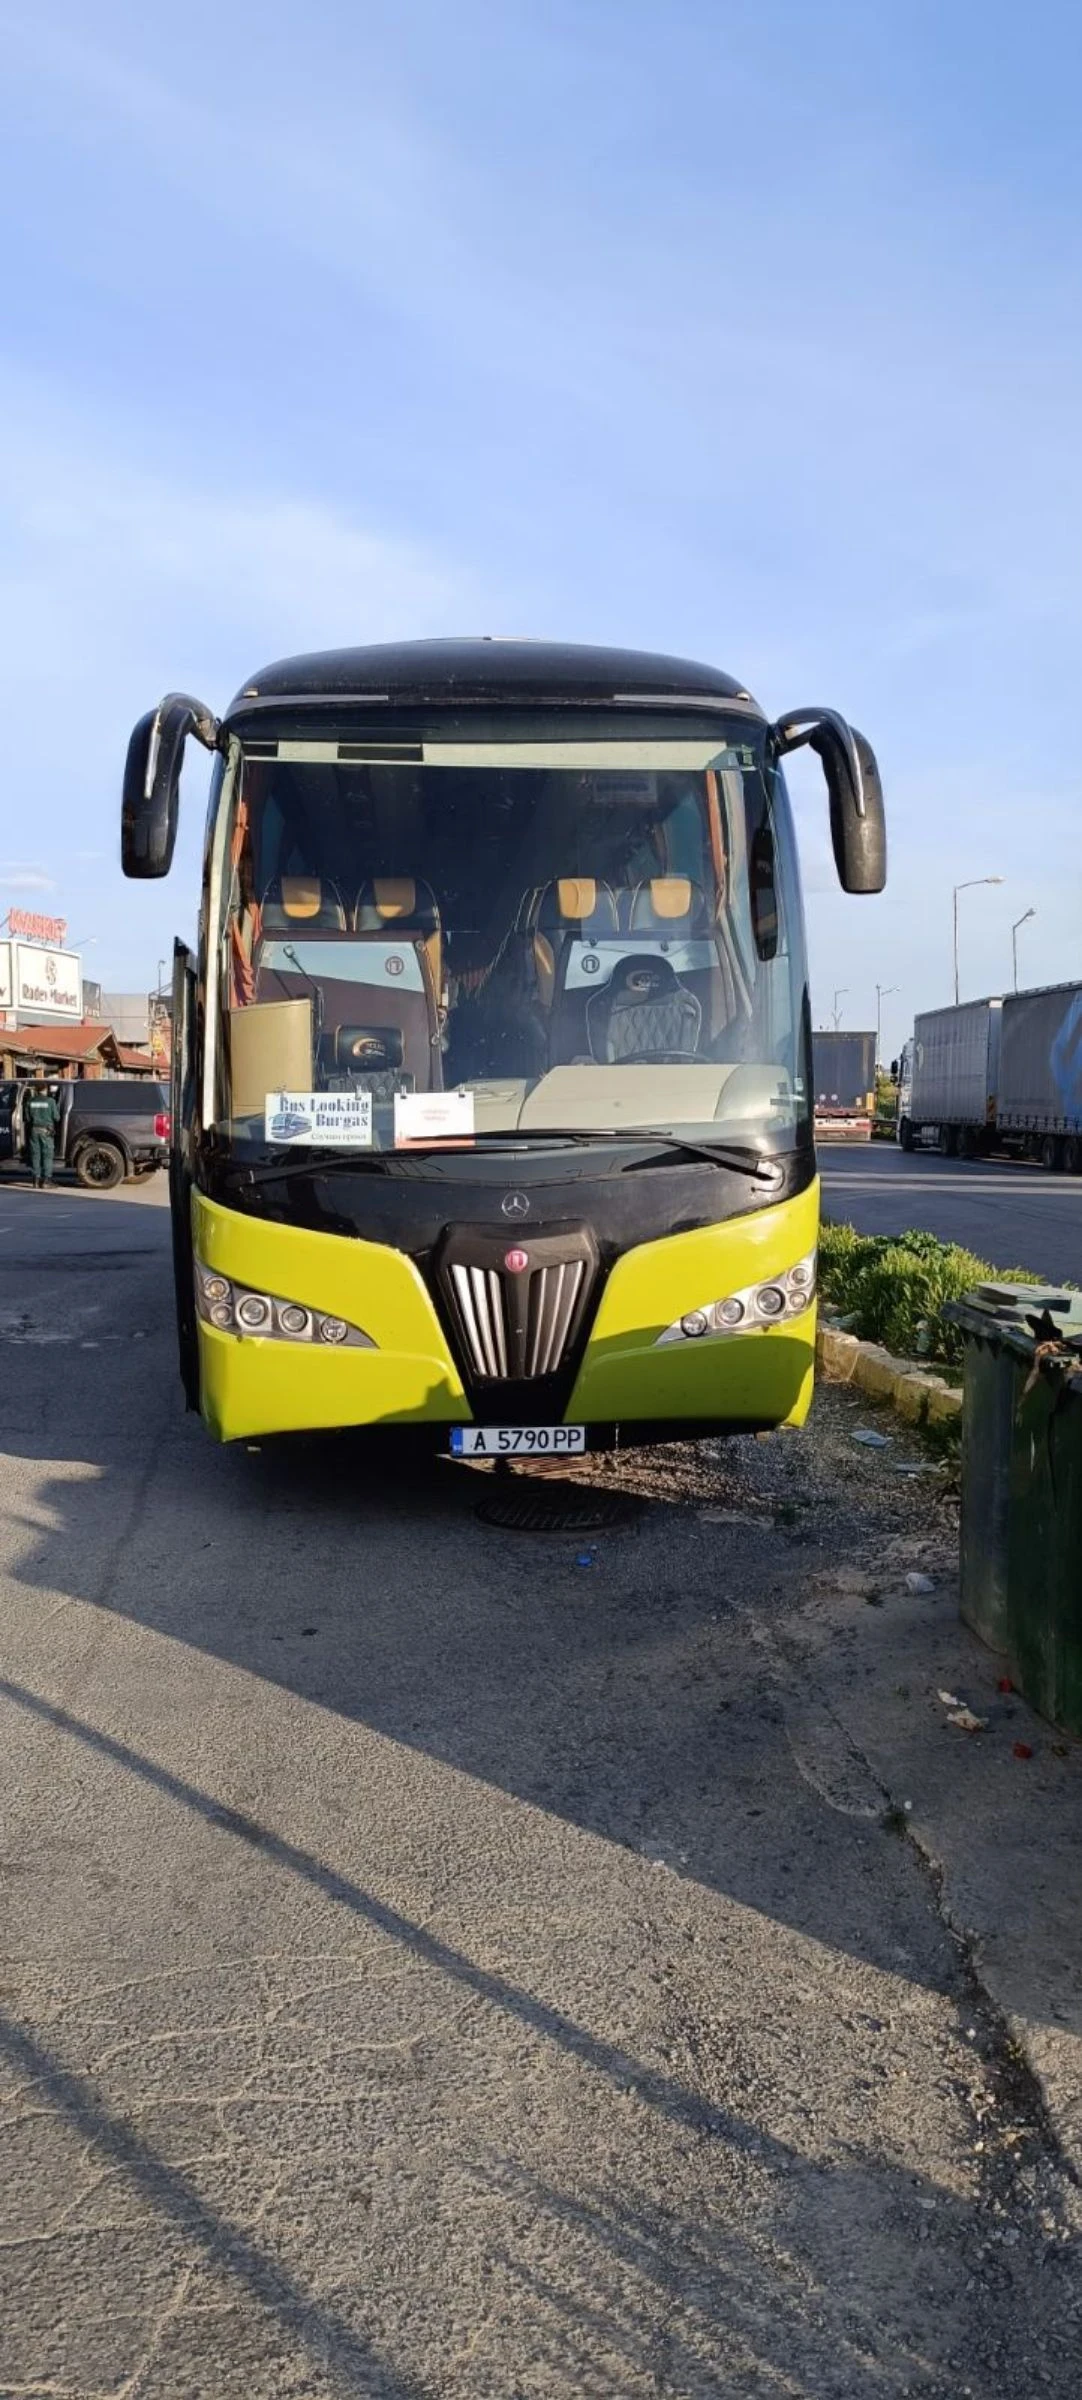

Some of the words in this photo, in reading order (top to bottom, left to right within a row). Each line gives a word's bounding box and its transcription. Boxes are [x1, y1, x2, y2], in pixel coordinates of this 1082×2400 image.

[279, 1096, 305, 1112] Bus
[310, 1098, 369, 1114] Looking
[316, 1113, 368, 1128] Burgas
[473, 1430, 487, 1451] A
[498, 1429, 550, 1450] 5790
[553, 1428, 582, 1449] PP
